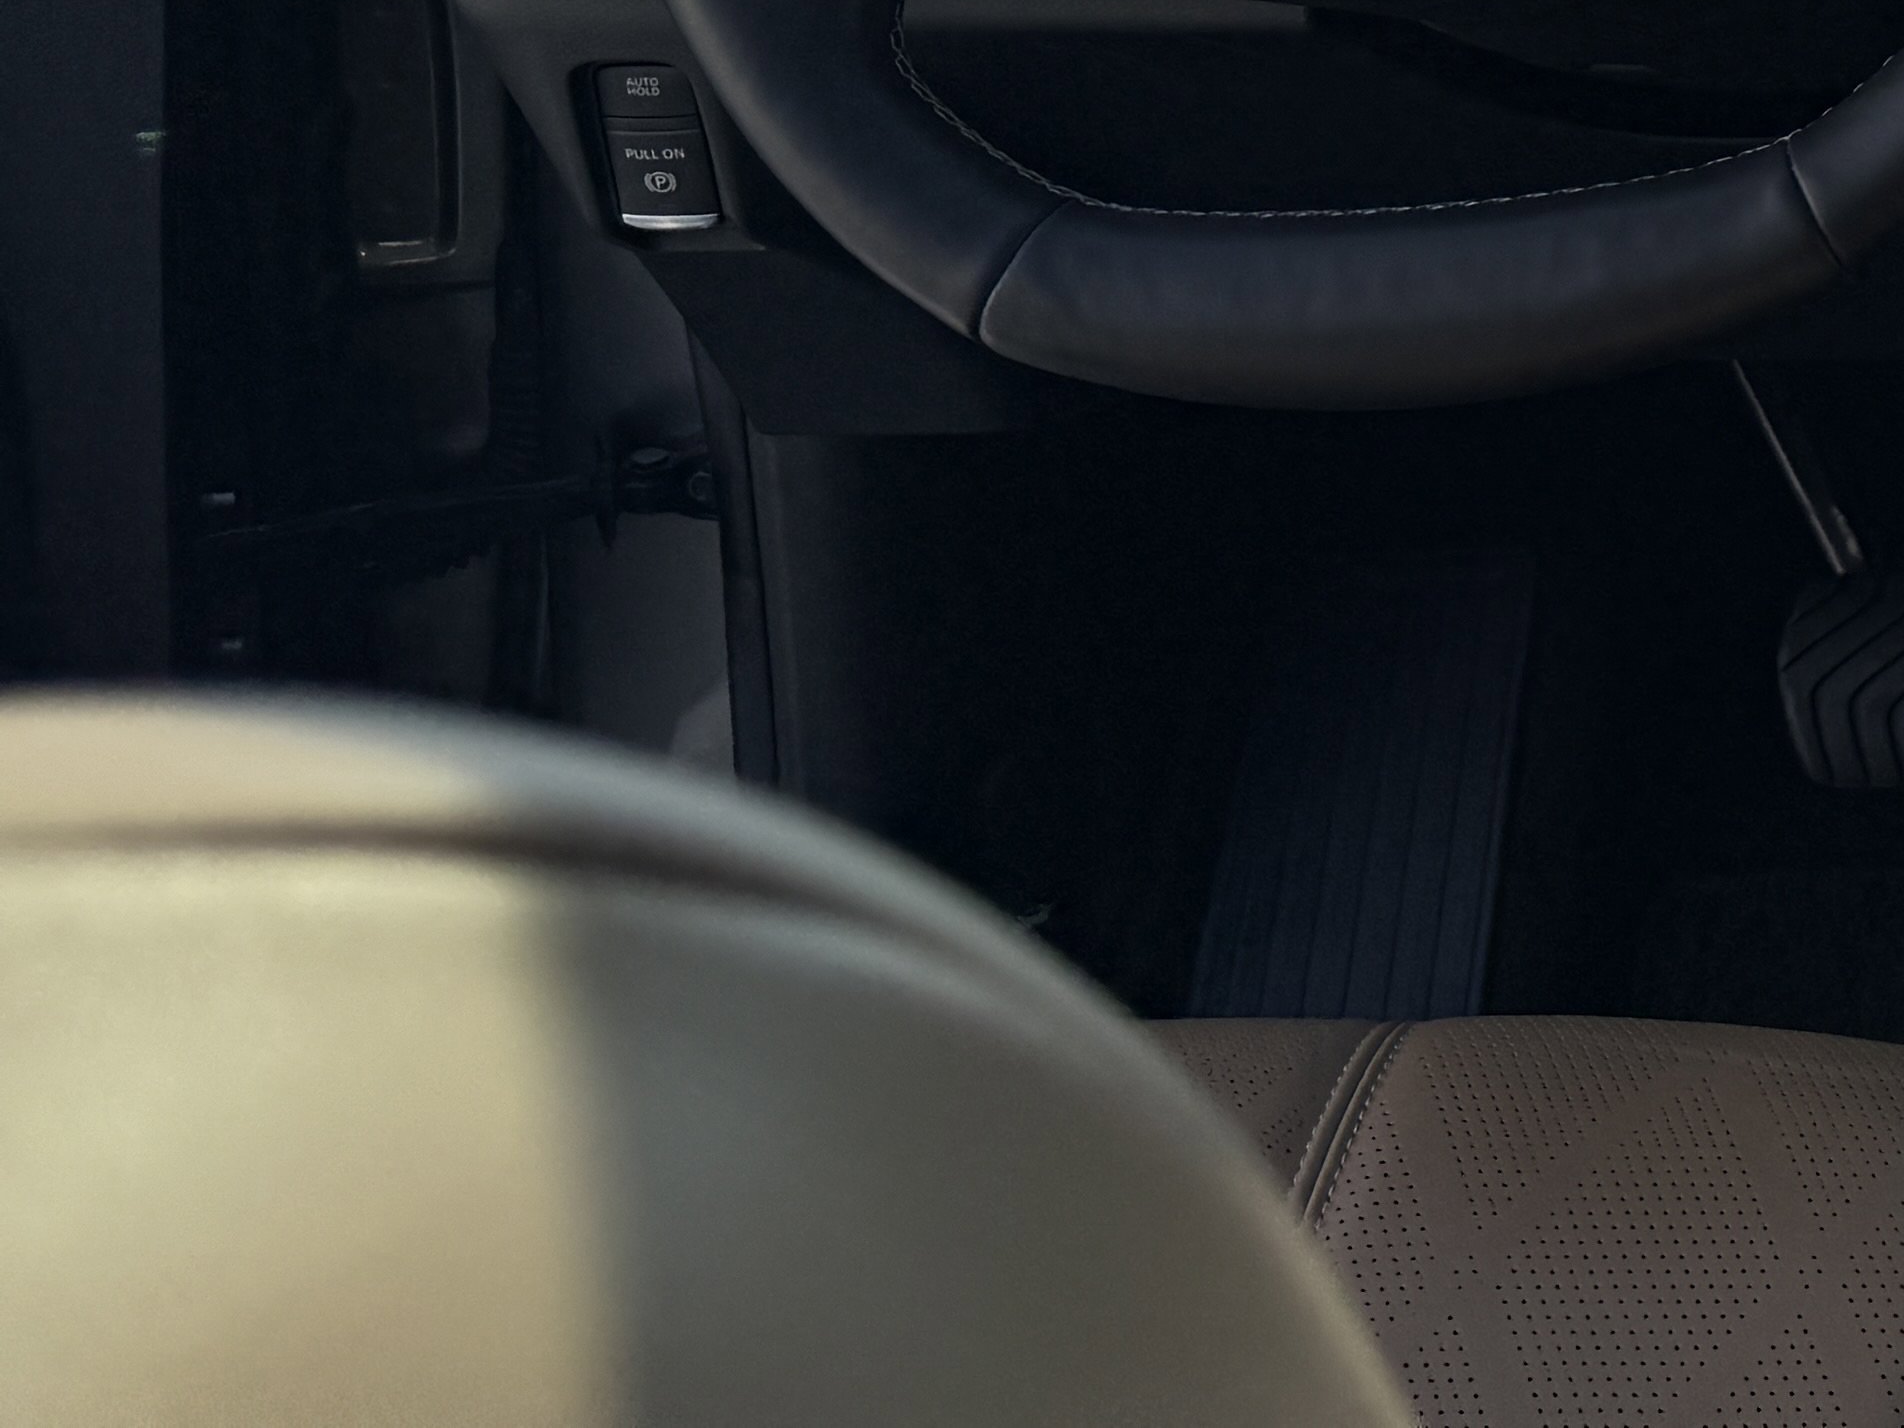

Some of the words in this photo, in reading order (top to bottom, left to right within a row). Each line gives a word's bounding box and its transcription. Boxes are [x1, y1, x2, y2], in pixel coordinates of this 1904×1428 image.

[626, 76, 659, 87] AUTO
[627, 87, 661, 97] HOLD
[624, 148, 660, 161] PULL
[661, 147, 686, 160] ON
